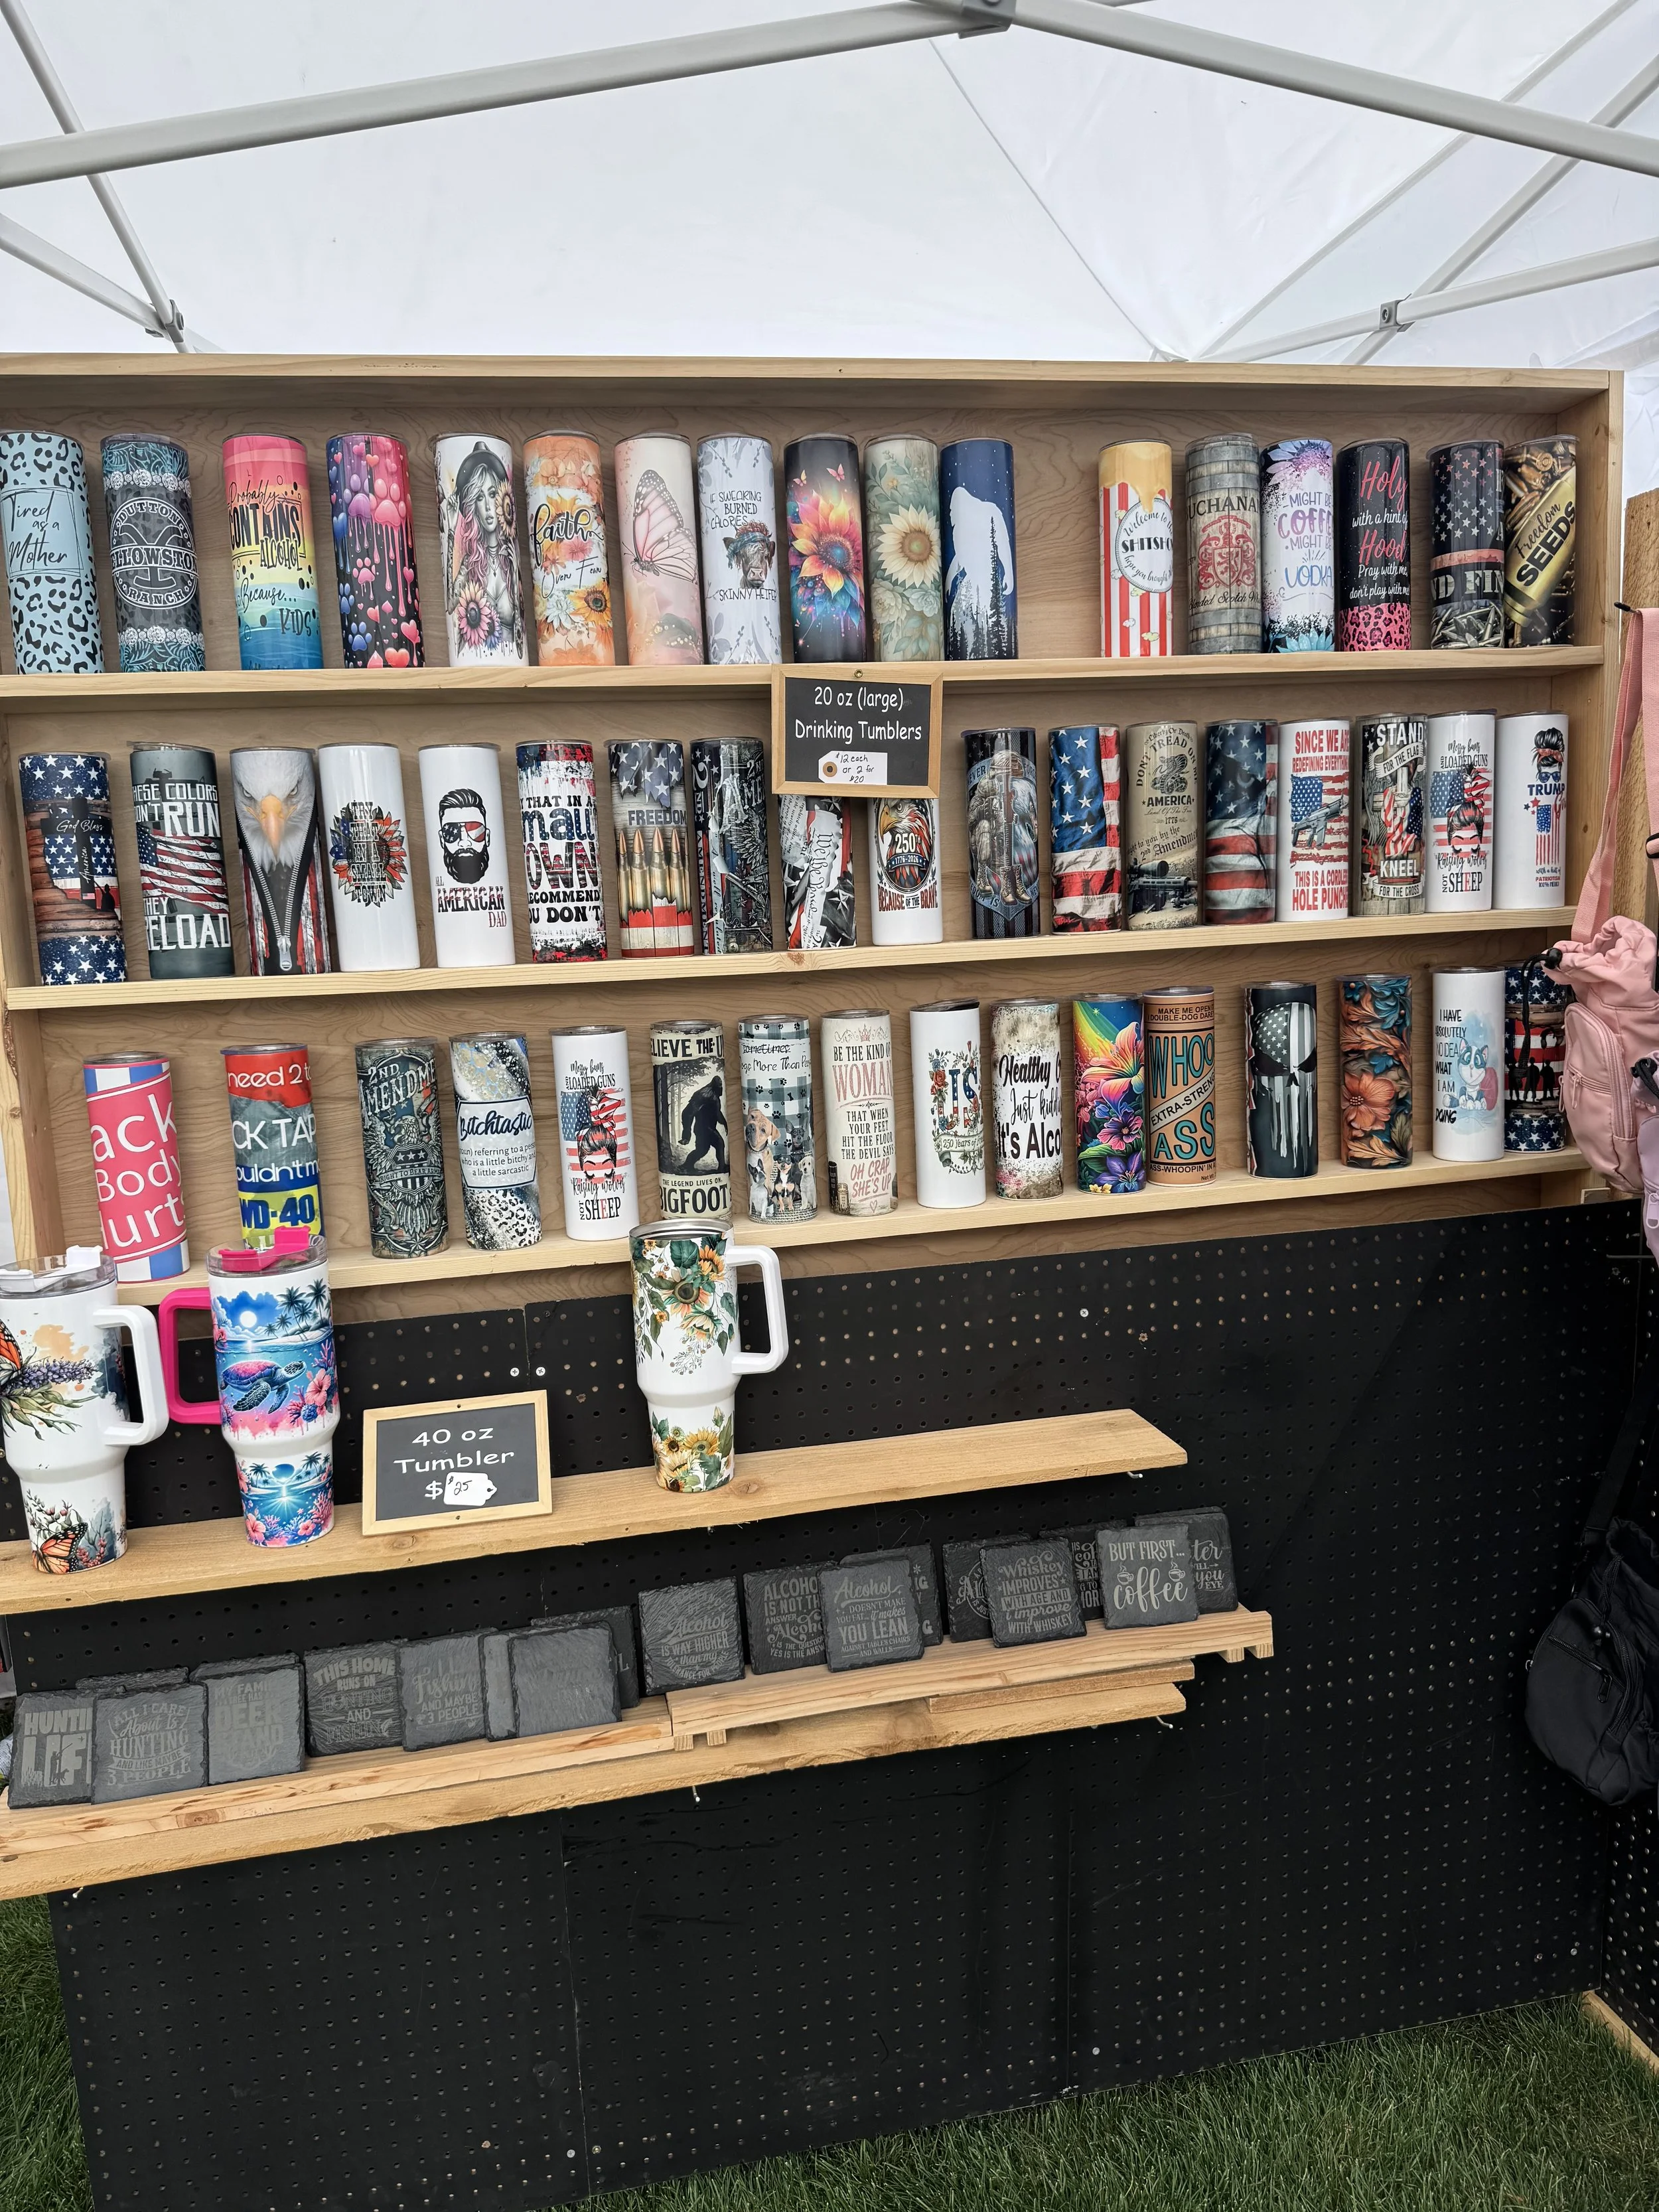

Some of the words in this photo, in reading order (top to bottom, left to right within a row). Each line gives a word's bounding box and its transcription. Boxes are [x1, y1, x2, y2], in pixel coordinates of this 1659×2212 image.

[1360, 455, 1407, 510] Holy
[228, 480, 278, 513] Probably
[709, 494, 715, 504] IF
[719, 491, 762, 502] SWEARING
[1, 491, 55, 532] Tired
[117, 502, 180, 525] DUTTON
[725, 504, 757, 514] BURNED
[229, 502, 301, 550] CONTAINS
[711, 516, 748, 530] CALORIES
[1514, 503, 1561, 559] Freedom
[3, 530, 67, 570] Mother
[260, 537, 303, 571] ALCOHOL
[1359, 530, 1407, 565] Hood
[1516, 501, 1575, 587] SEEDS
[128, 587, 184, 605] RANCH
[719, 589, 752, 601] SKINNY
[755, 589, 777, 601] HEIFER
[1350, 583, 1368, 599] don't
[1369, 583, 1387, 599] play
[1388, 582, 1403, 596] with
[280, 608, 311, 637] KIDS
[815, 687, 831, 705] 20
[837, 692, 853, 706] oz
[858, 687, 903, 712] (large)
[796, 719, 853, 744] Drinking
[858, 721, 922, 740] Tumblers
[1295, 731, 1323, 754] SINCE
[1327, 730, 1338, 752] WE
[1340, 730, 1349, 751] ARE
[1376, 723, 1423, 747] STAND
[835, 753, 849, 763] $12
[1292, 756, 1323, 773] REDEFINING
[1383, 763, 1394, 773] FOR
[1396, 755, 1407, 767] THE
[1407, 746, 1419, 761] FLAG
[1445, 755, 1471, 768] LOADED
[1474, 755, 1488, 767] GUNS
[165, 783, 217, 800] COLORS
[1528, 783, 1565, 796] TRUMP
[351, 802, 373, 820] TRY
[1147, 795, 1192, 807] AMERICA
[165, 802, 221, 837] RUN
[628, 809, 687, 826] FREEDOM
[350, 823, 379, 842] THAT
[80, 847, 94, 883] America
[352, 863, 386, 883] SMALL
[1380, 860, 1419, 878] KNEEL
[1295, 871, 1309, 887] THIS
[1312, 870, 1319, 887] IS
[1321, 871, 1325, 887] A
[1449, 871, 1482, 892] SHEEP
[354, 885, 386, 904] TOWN
[437, 887, 505, 913] AMERICAN
[878, 884, 905, 912] BECAUSE
[906, 898, 911, 907] OF
[921, 883, 938, 909] BRAVE
[1292, 889, 1319, 911] HOLE
[1380, 885, 1390, 896] FOR
[1394, 885, 1403, 897] THE
[1405, 883, 1419, 896] CROSS
[488, 911, 506, 927] DAD
[547, 906, 601, 923] DON'T
[1440, 1009, 1442, 1021] I
[1443, 1009, 1461, 1021] HAVE
[1435, 1027, 1467, 1039] ABSOLUTELY
[834, 1047, 843, 1061] BE
[846, 1046, 863, 1061] THE
[867, 1045, 884, 1059] KIND
[886, 1043, 891, 1057] OF
[754, 1059, 777, 1071] More
[780, 1057, 799, 1070] Than
[999, 1056, 1050, 1088] Healthy
[1435, 1062, 1451, 1076] WHAT
[228, 1065, 284, 1088] need
[289, 1065, 303, 1084] 2
[368, 1064, 399, 1086] 2ND
[569, 1076, 595, 1089] LOADED
[598, 1074, 616, 1087] GUNS
[833, 1061, 892, 1102] WOMAN
[847, 1110, 867, 1121] THAT
[871, 1108, 889, 1120] WHEN
[1011, 1088, 1039, 1126] Just
[1435, 1110, 1457, 1124] DOING
[461, 1110, 532, 1141] Bitchtastic
[849, 1124, 871, 1134] YOUR
[874, 1120, 889, 1133] FEET
[1155, 1102, 1215, 1161] ASS
[842, 1136, 855, 1147] HIT
[858, 1135, 873, 1145] THE
[876, 1132, 893, 1145] FLOOR
[508, 1155, 528, 1163] bitchy
[842, 1149, 855, 1159] THE
[859, 1149, 881, 1159] DEVIL
[883, 1147, 894, 1157] SAYS
[498, 1165, 529, 1175] sarcastic
[851, 1164, 865, 1179] OH
[868, 1157, 890, 1177] CRAP
[672, 1178, 693, 1187] LEGEND
[852, 1178, 879, 1198] SHE'S
[882, 1174, 891, 1190] UP
[240, 1195, 315, 1229] WD-40
[585, 1197, 621, 1220] SHEEP
[412, 1429, 451, 1447] 40
[461, 1428, 493, 1441] oz
[394, 1450, 514, 1474] Tumbler
[448, 1475, 472, 1495] $25
[1109, 1543, 1135, 1562] BUT
[1139, 1540, 1185, 1562] FIRST...
[998, 1551, 1064, 1578] Whiskey
[834, 1576, 905, 1603] Alcohol
[1002, 1574, 1059, 1595] IMPROVES
[1114, 1566, 1188, 1612] coffee
[1004, 1595, 1026, 1609] WITH
[1031, 1593, 1048, 1605] AGE
[1050, 1589, 1068, 1602] AND
[839, 1623, 867, 1645] YOU
[872, 1617, 908, 1639] LEAN
[1008, 1620, 1031, 1634] WITH
[1034, 1613, 1073, 1631] WHISKEY
[662, 1645, 670, 1657] IS
[672, 1641, 691, 1655] WAY
[695, 1631, 729, 1652] HIGHER
[868, 1639, 887, 1649] TABLES
[314, 1660, 350, 1685] THIS
[352, 1658, 396, 1676] HOME
[110, 1728, 188, 1758] HUNTING
